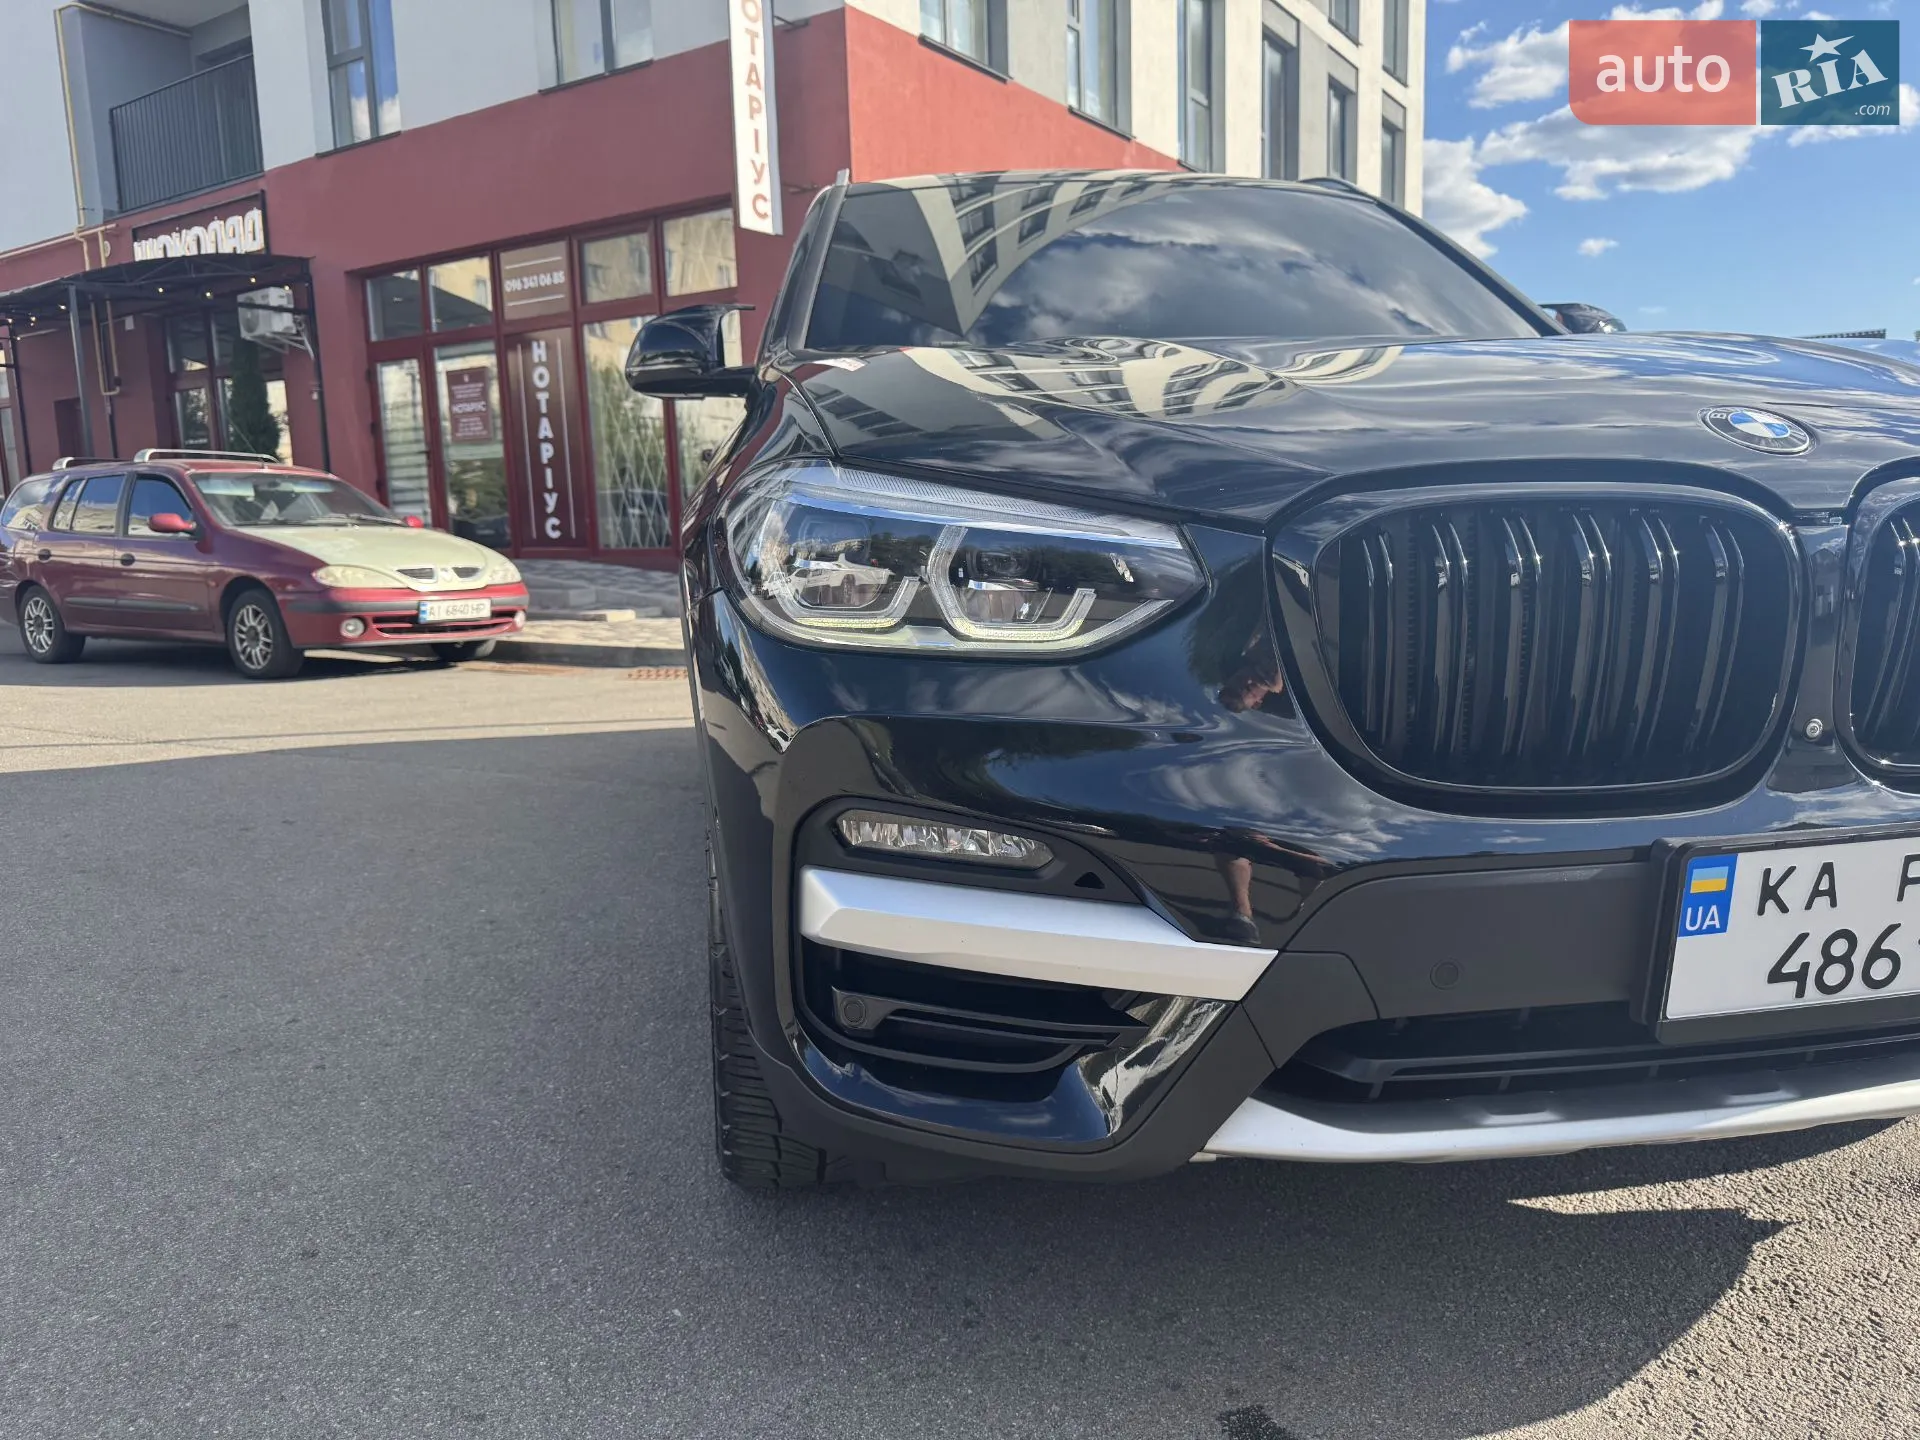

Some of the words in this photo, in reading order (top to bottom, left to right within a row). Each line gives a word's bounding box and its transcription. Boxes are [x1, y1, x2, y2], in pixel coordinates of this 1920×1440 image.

[531, 339, 562, 540] НОТАРІУС
[1684, 904, 1721, 932] UA
[1757, 861, 1838, 916] KA
[1766, 922, 1920, 1000] 486
